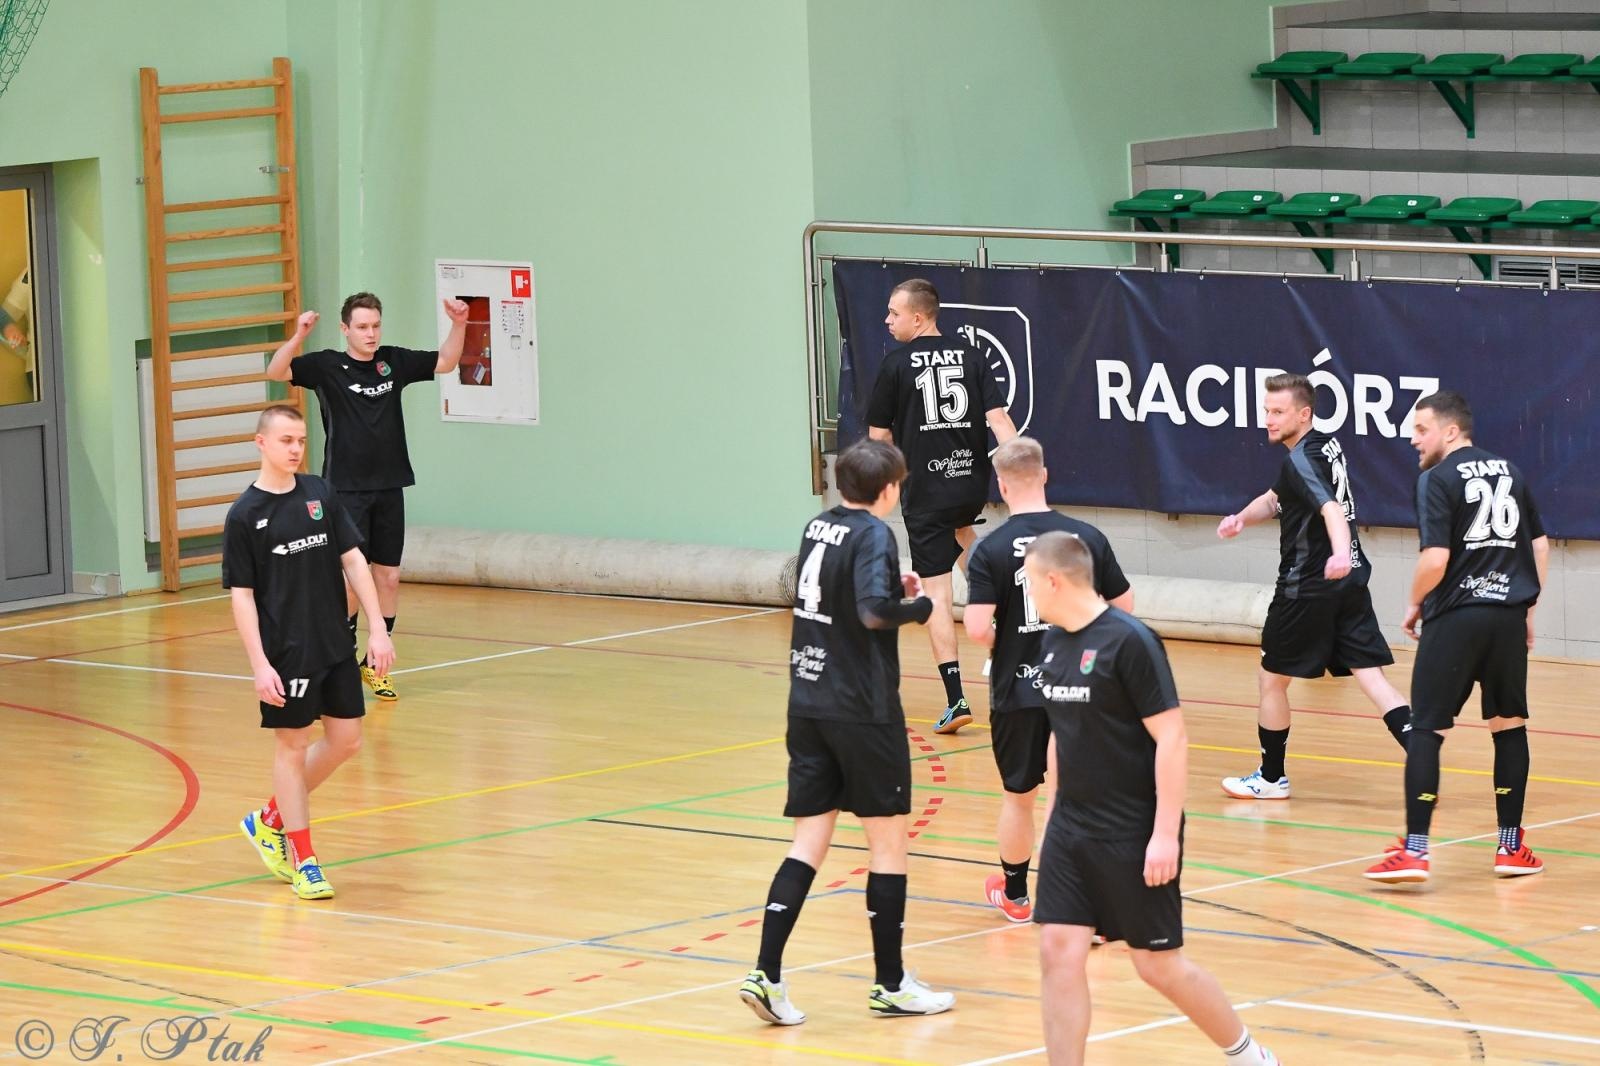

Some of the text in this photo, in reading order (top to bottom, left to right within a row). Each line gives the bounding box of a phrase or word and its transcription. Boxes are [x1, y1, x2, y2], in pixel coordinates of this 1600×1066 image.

[910, 349, 965, 367] START
[914, 365, 969, 424] 15
[927, 457, 974, 472] Wiktoria
[1456, 460, 1510, 480] START
[1463, 475, 1520, 541] 26
[805, 519, 851, 546] START
[797, 541, 827, 613] 4
[289, 678, 310, 698] 17
